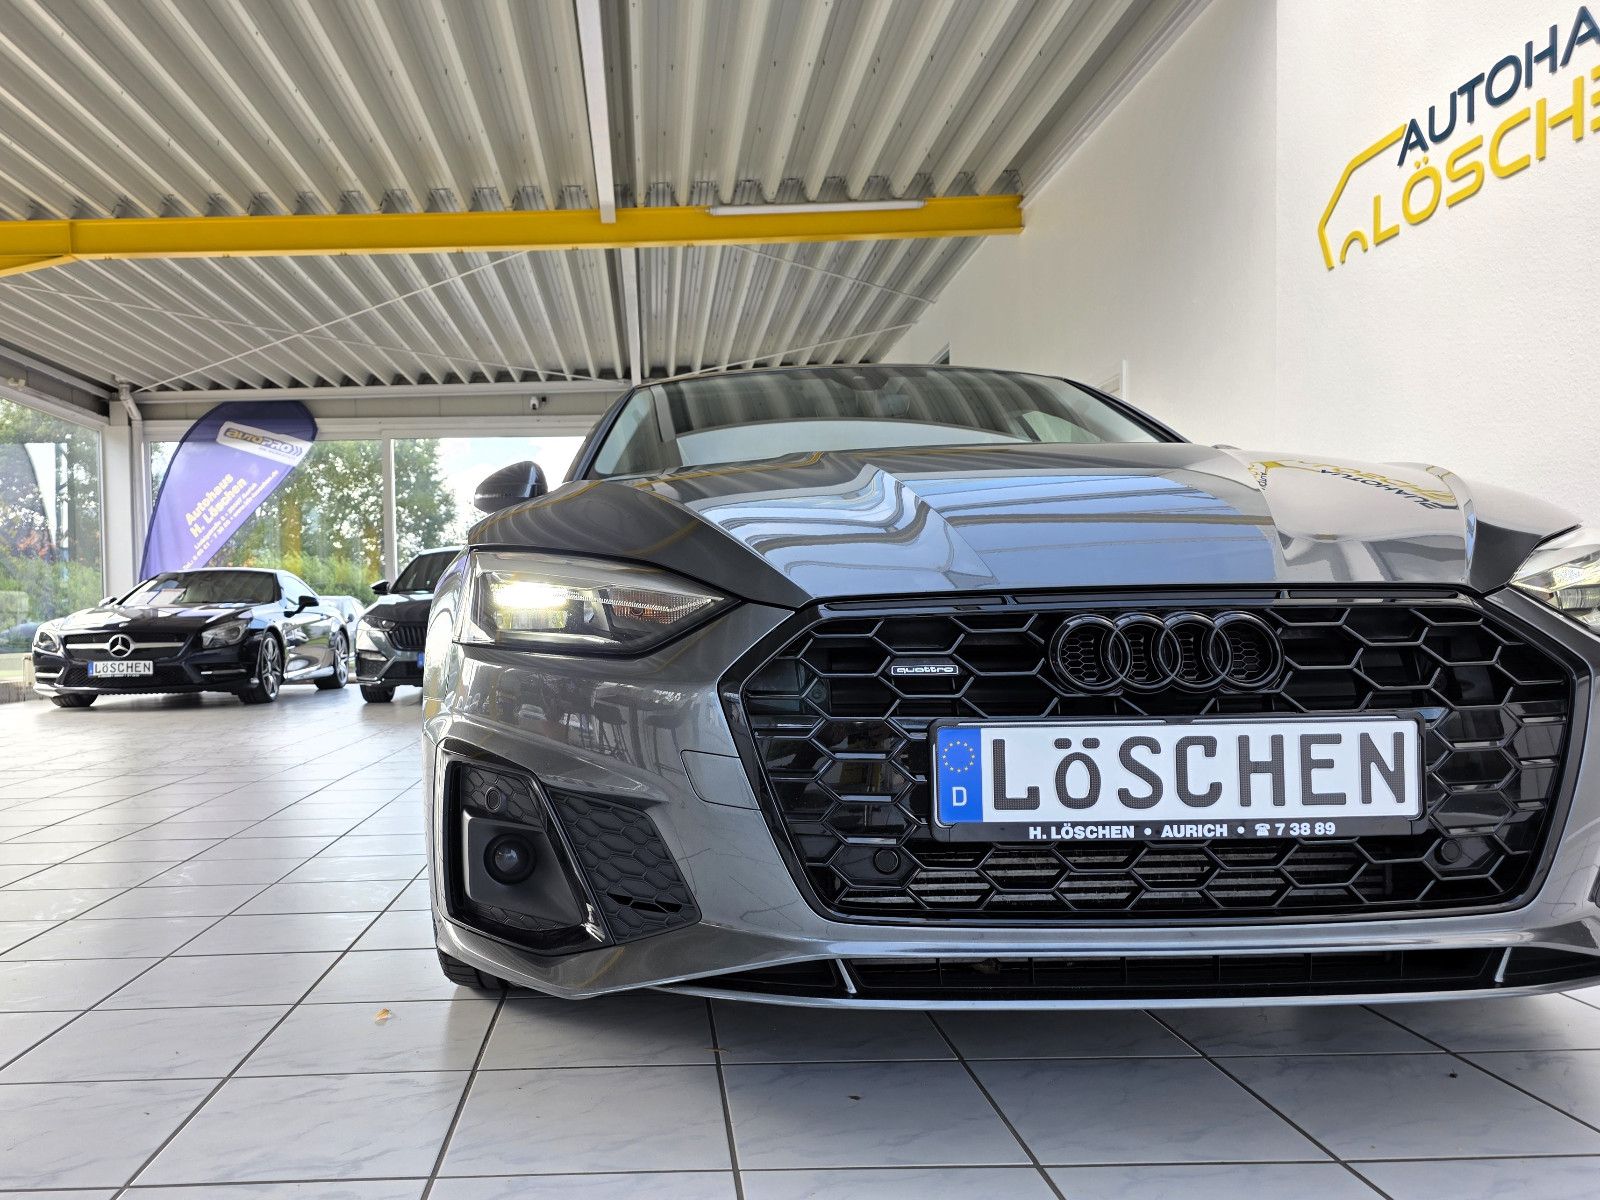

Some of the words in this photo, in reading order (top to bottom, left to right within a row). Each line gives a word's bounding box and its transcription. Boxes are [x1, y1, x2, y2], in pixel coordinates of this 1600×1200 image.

[1397, 6, 1600, 166] AUTOHA
[185, 474, 233, 525] Autohaus
[952, 786, 967, 807] D
[992, 731, 1406, 811] LÖSCHEN
[1029, 826, 1046, 839] H.
[1051, 823, 1135, 839] LÖSCHEN
[1161, 823, 1228, 838] AURICH
[1275, 823, 1285, 836] 7
